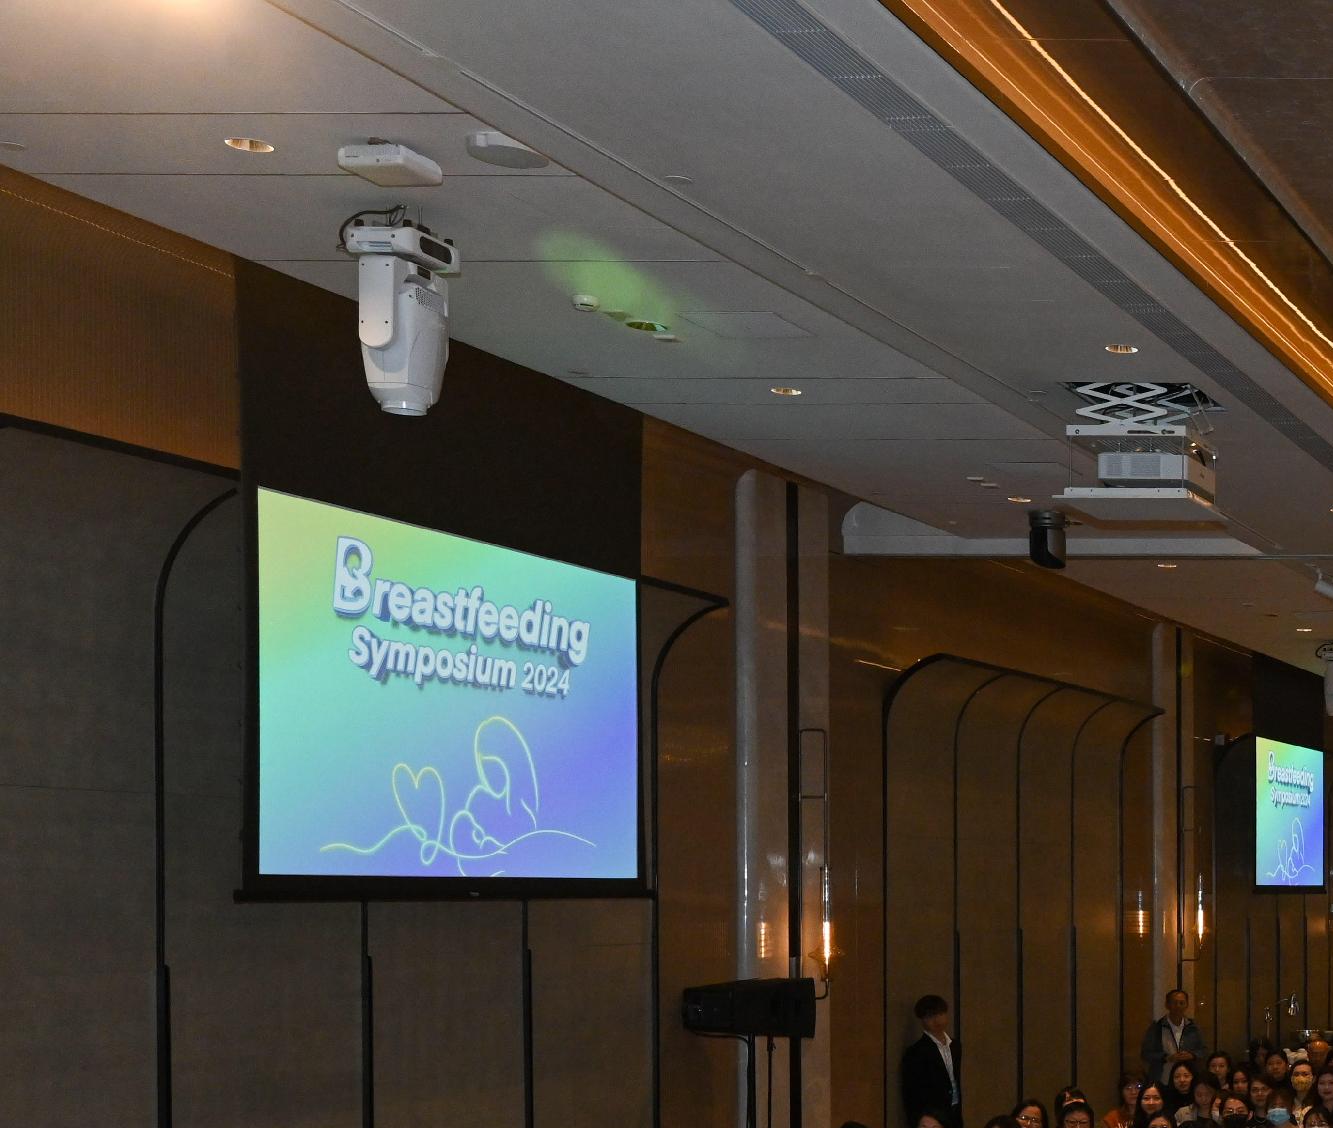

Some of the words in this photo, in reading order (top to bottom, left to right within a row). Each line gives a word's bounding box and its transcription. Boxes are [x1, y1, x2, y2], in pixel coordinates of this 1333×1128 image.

[334, 535, 591, 664] Breastfeeding
[349, 626, 517, 684] Symposium
[522, 663, 570, 696] 2024
